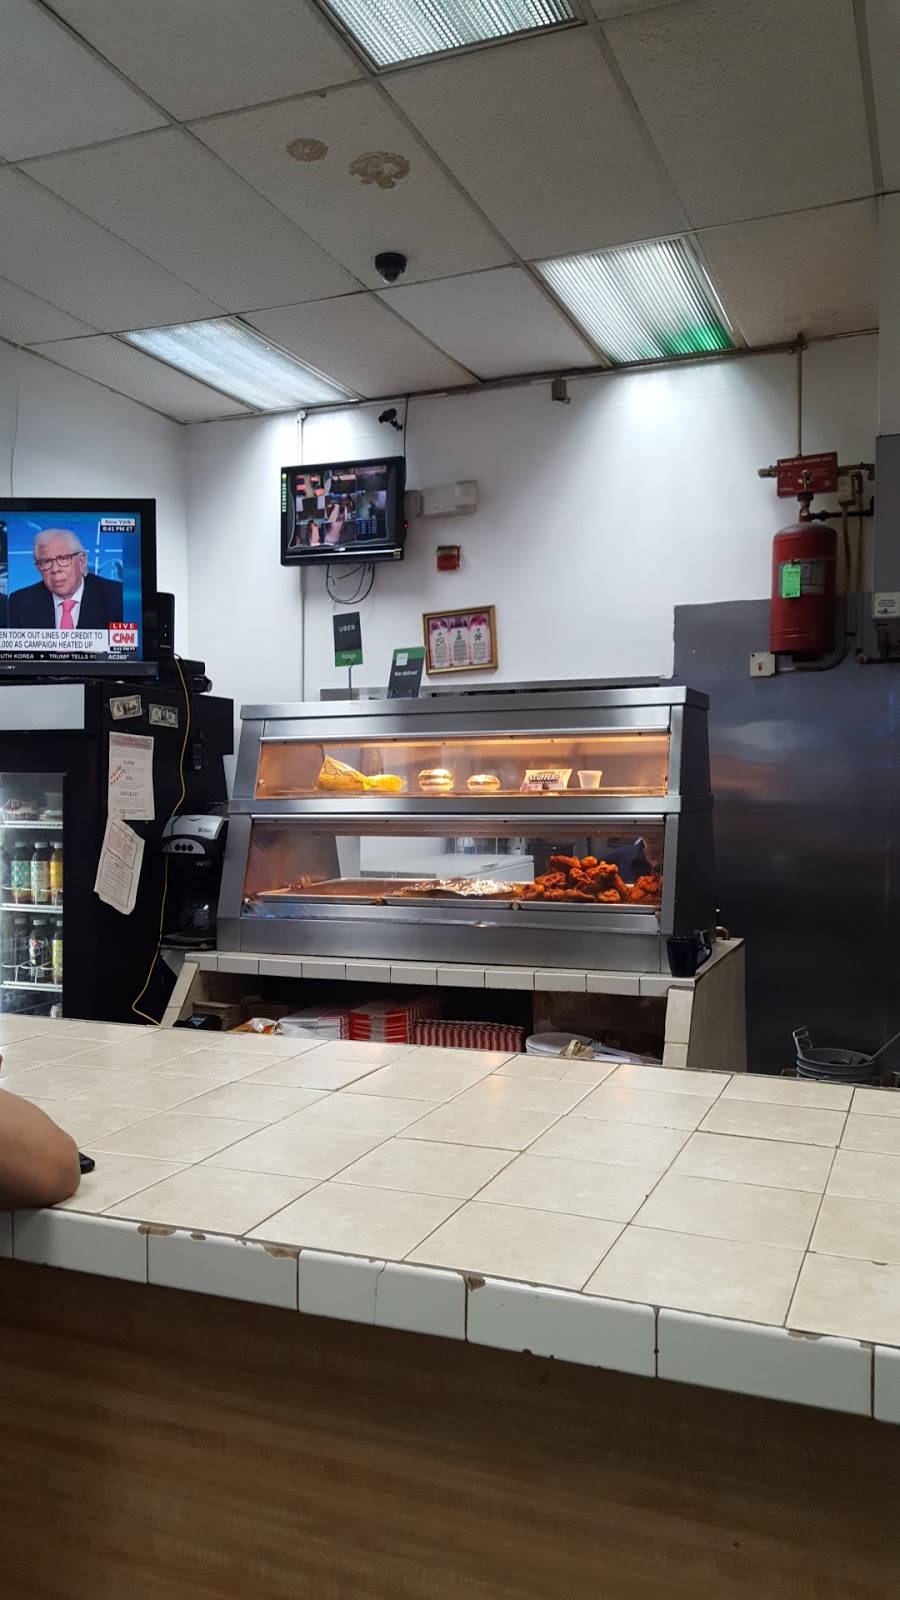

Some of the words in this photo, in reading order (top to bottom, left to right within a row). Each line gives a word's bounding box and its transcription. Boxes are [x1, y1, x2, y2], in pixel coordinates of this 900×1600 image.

[338, 624, 355, 632] UBER
[9, 631, 26, 640] TOOK
[27, 631, 40, 640] OUT
[41, 631, 60, 640] LINES
[61, 631, 70, 640] OF
[70, 631, 93, 640] CREDIT
[94, 631, 103, 640] TO
[112, 632, 135, 643] CNN
[14, 640, 23, 649] AS
[23, 640, 58, 649] CAMPAIGN
[59, 640, 83, 649] HEATED
[84, 640, 94, 649] UP
